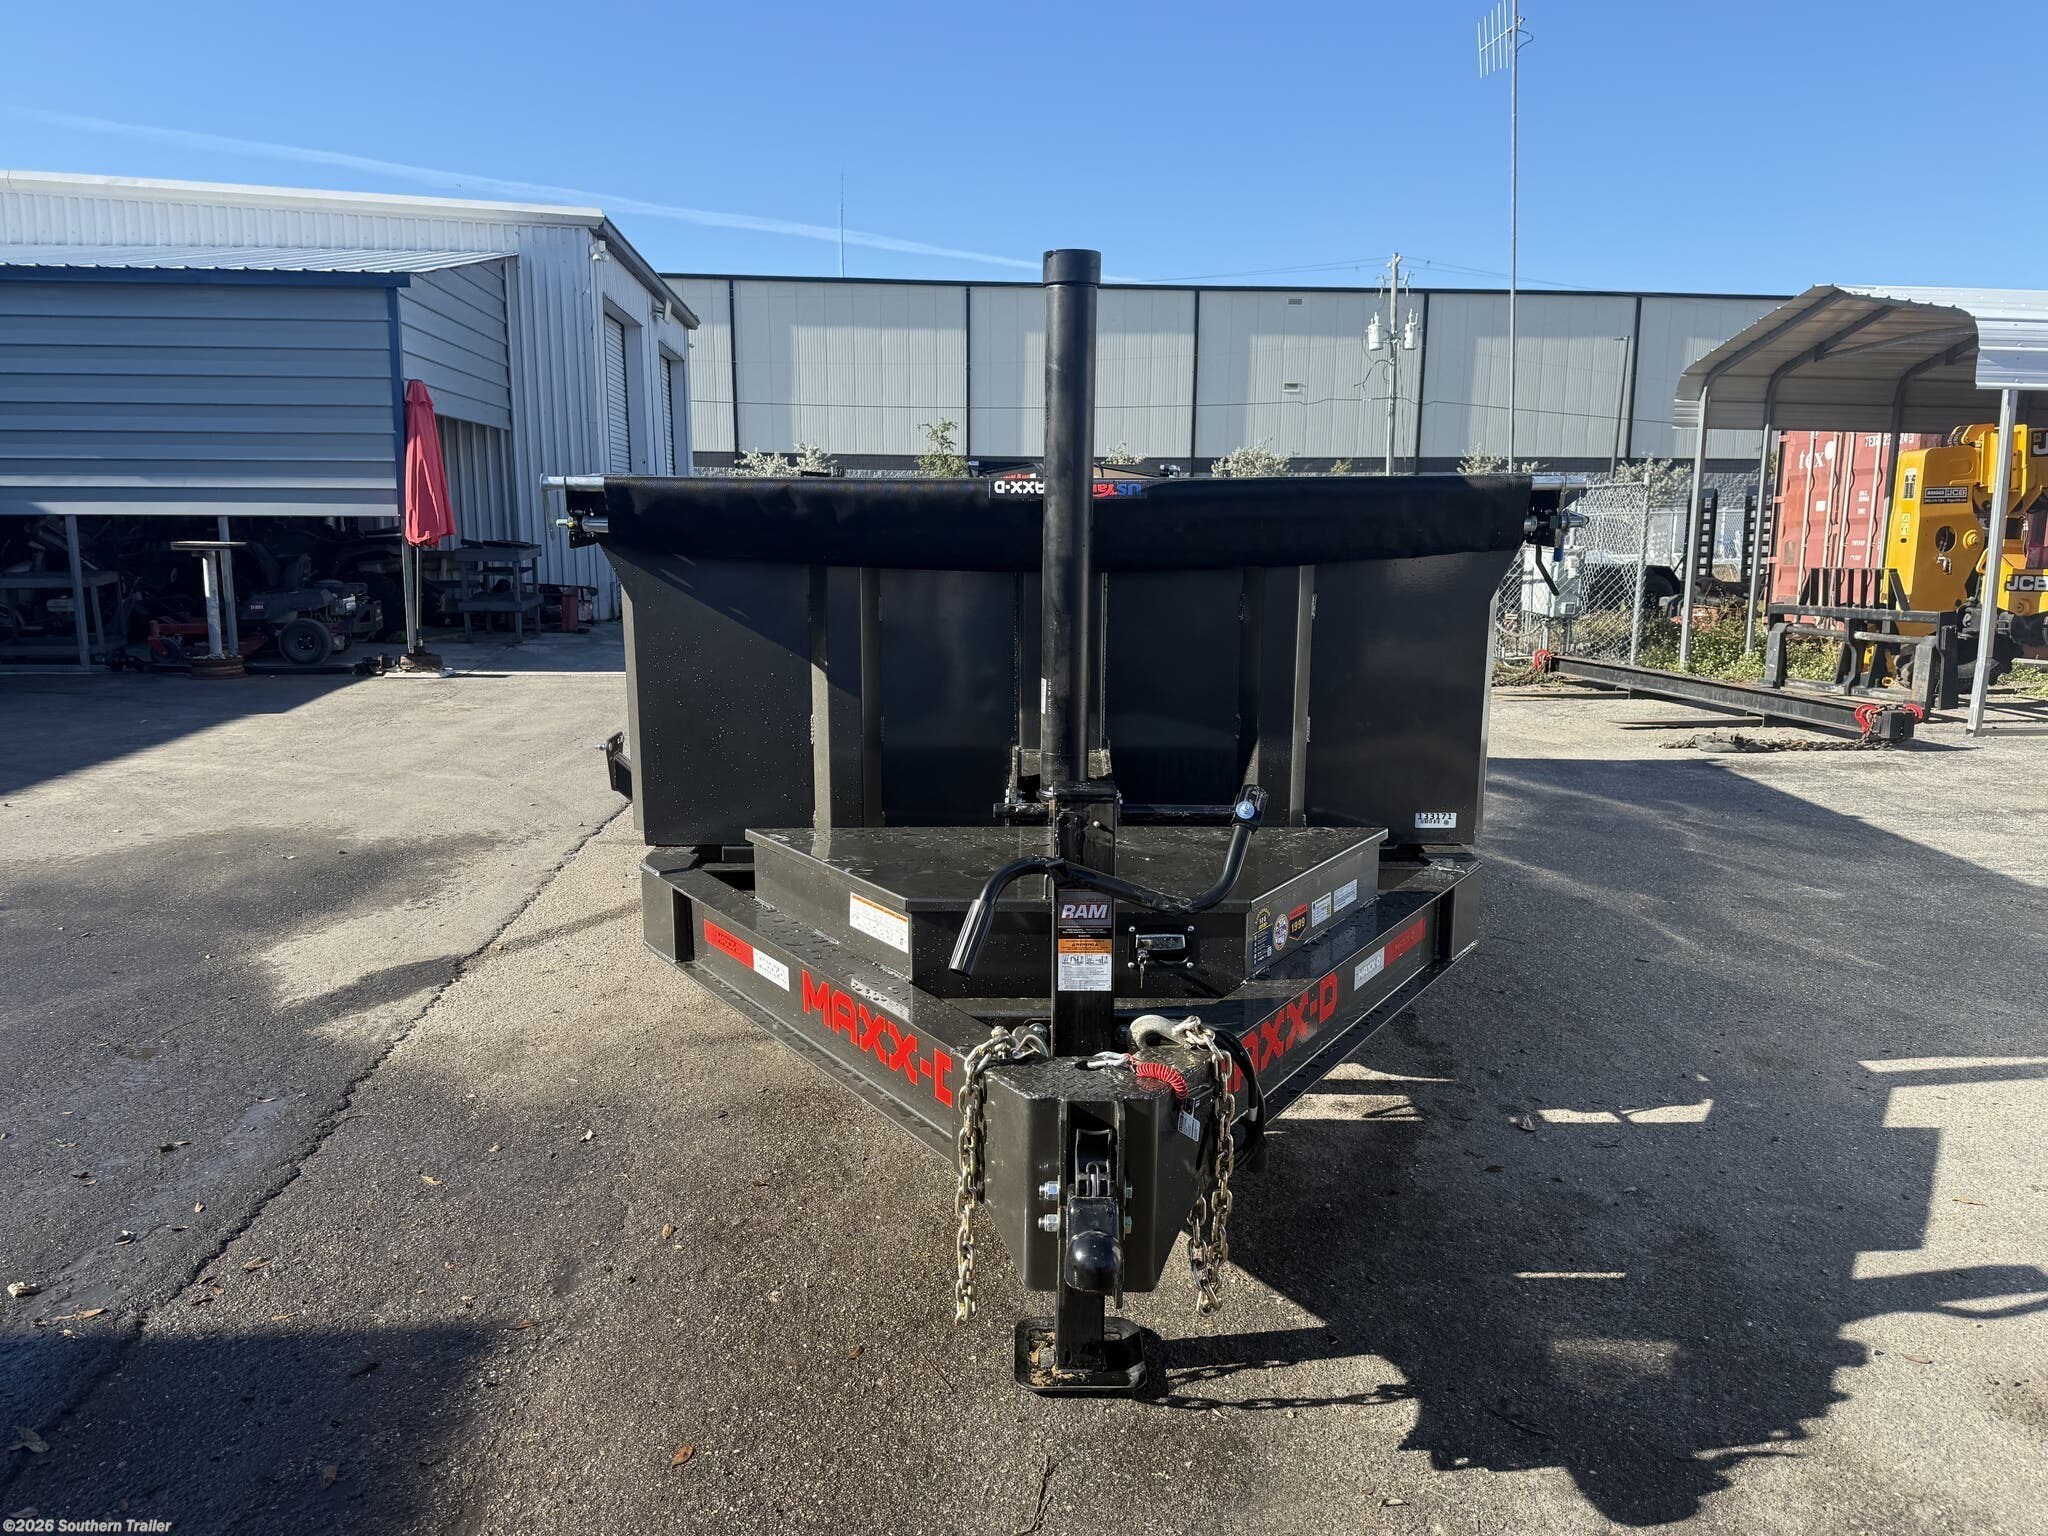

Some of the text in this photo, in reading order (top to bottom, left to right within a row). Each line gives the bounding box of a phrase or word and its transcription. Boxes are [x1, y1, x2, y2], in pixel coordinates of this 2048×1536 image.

[994, 480, 1045, 494] AXX-D
[1061, 904, 1108, 919] RAM
[1291, 917, 1306, 933] 1999
